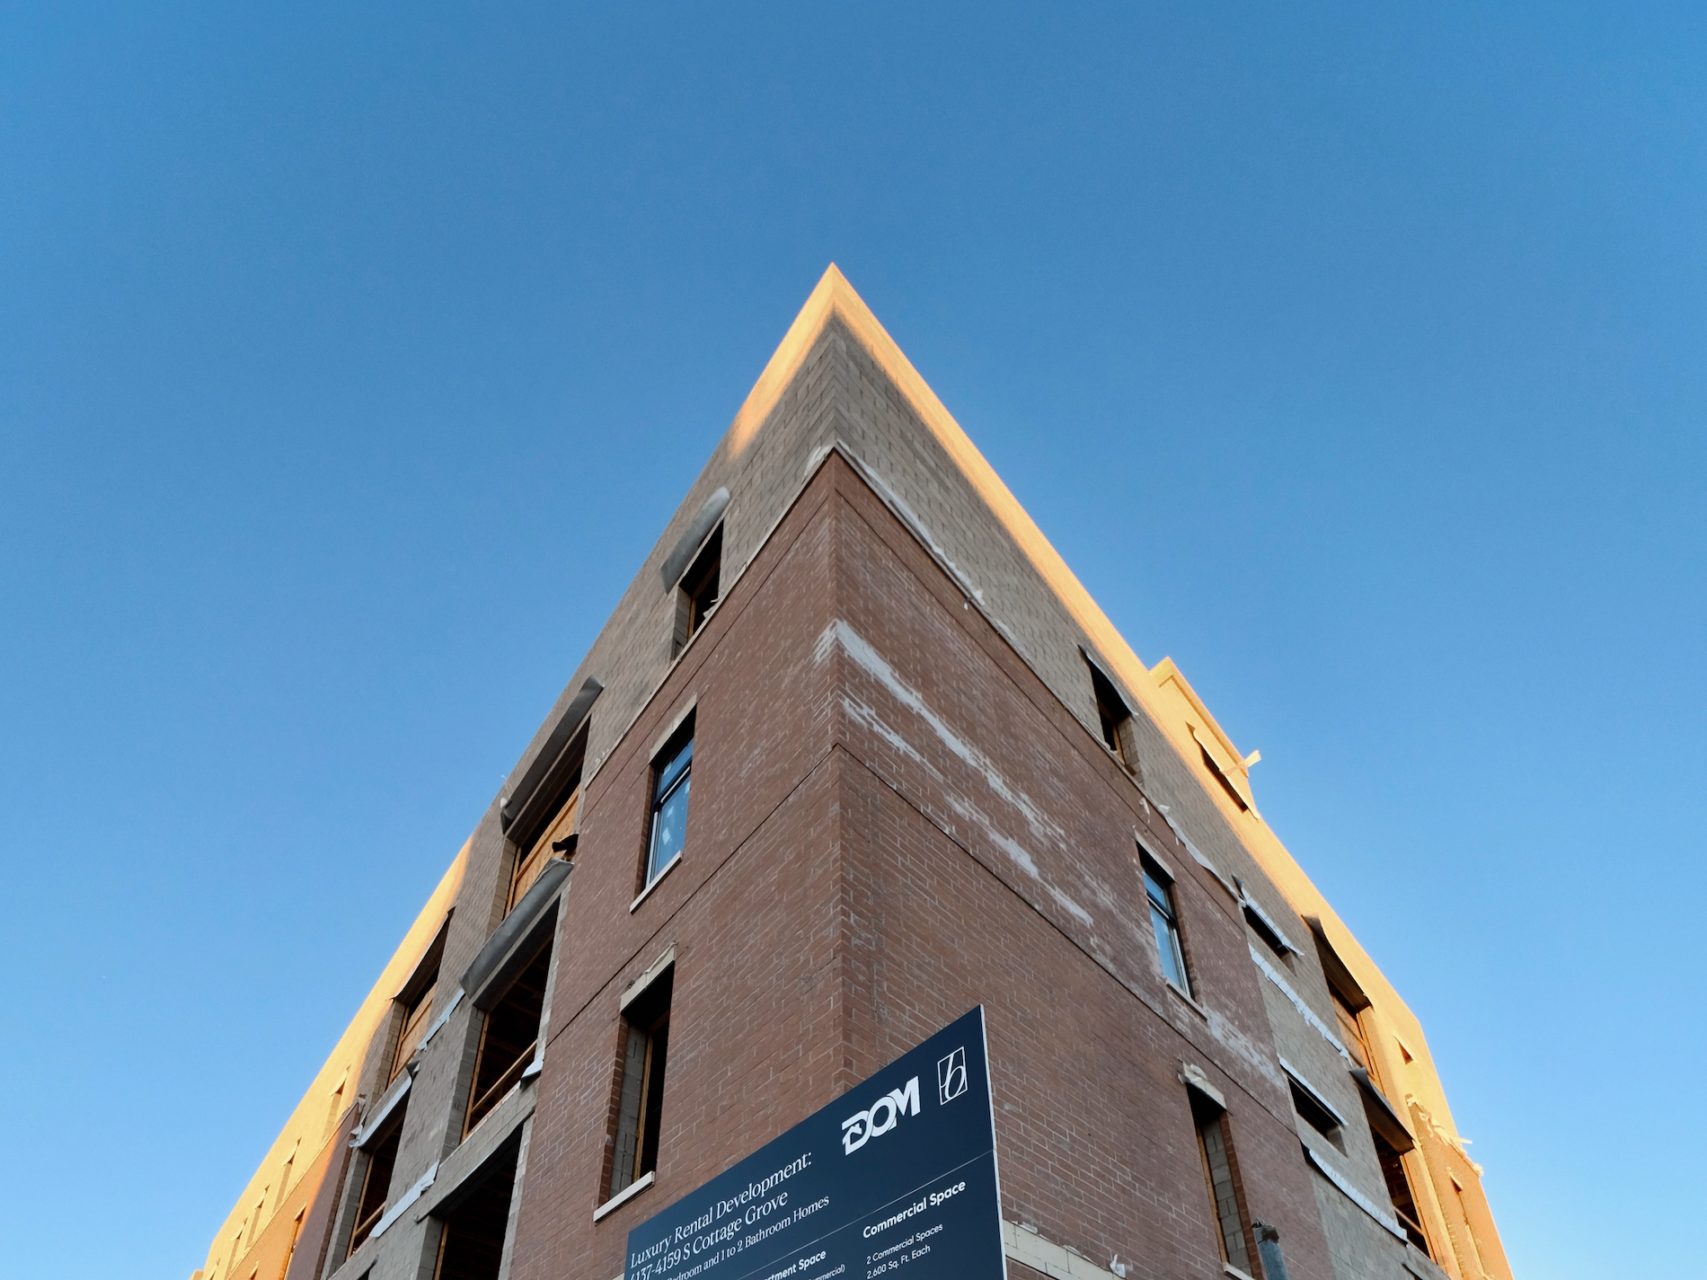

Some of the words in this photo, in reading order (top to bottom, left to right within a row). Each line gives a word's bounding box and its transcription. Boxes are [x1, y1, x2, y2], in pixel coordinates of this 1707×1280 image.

[841, 1076, 921, 1156] DOM
[631, 1235, 672, 1269] Luxury
[674, 1206, 713, 1244] Rental
[716, 1152, 812, 1220] Development:
[683, 1242, 691, 1260] S
[692, 1218, 742, 1254] Cottage
[745, 1191, 788, 1225] Grove
[703, 1252, 720, 1271] and
[726, 1246, 736, 1258] to
[737, 1240, 743, 1252] 2
[745, 1217, 791, 1248] Bathroom
[793, 1196, 829, 1223] Homes
[863, 1197, 927, 1239] Commercial
[929, 1181, 966, 1206] Space
[798, 1250, 827, 1271] Space
[866, 1256, 871, 1265] 2
[872, 1235, 915, 1262] Commercial
[915, 1224, 943, 1242] Spaces
[888, 1260, 899, 1270] Sq.
[911, 1244, 931, 1259] Each
